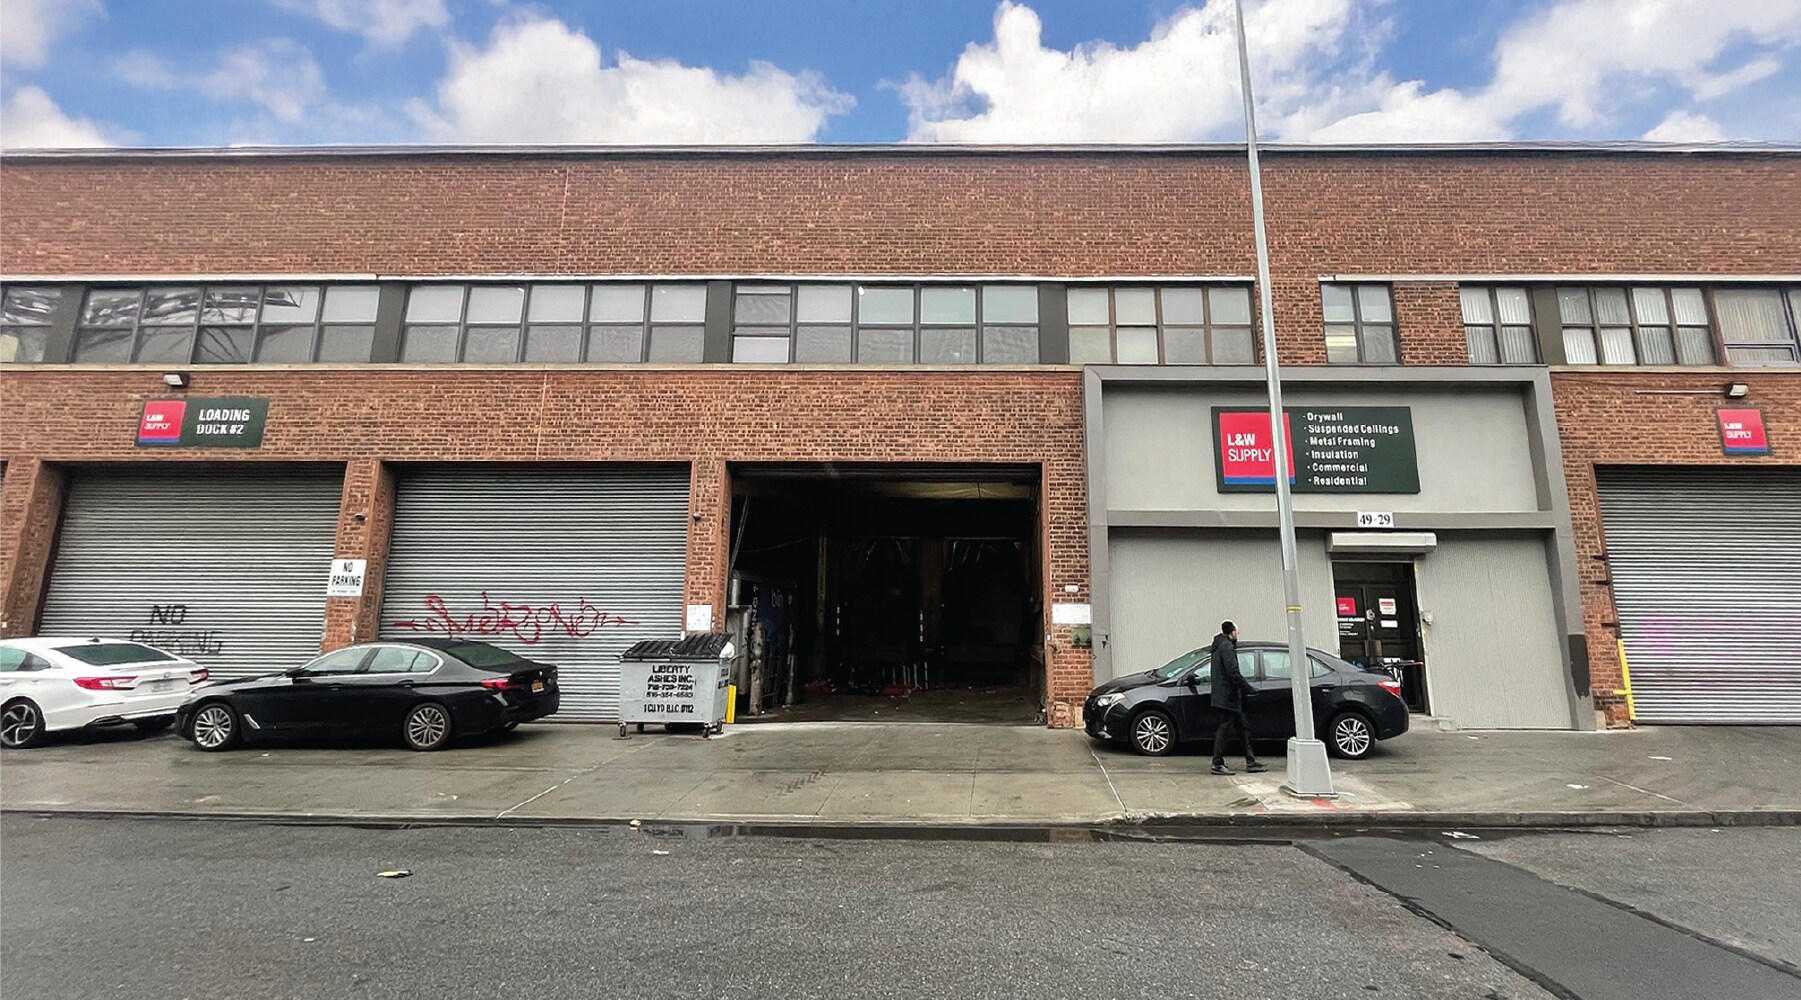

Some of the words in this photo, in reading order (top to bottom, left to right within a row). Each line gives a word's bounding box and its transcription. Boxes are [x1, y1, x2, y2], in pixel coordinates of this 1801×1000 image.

[198, 409, 250, 421] LOADING
[1307, 412, 1343, 422] Drywall
[196, 423, 228, 435] DOCK
[229, 423, 244, 435] #2
[1308, 425, 1359, 435] Suspended
[1361, 424, 1400, 434] Ceilings
[1725, 430, 1752, 439] SUPPLY
[1227, 433, 1256, 446] L&W
[1310, 437, 1336, 446] Metal
[1338, 437, 1376, 448] Framing
[1228, 449, 1272, 462] SUPPLY
[1311, 450, 1359, 460] Insulation
[1312, 463, 1368, 473] Commercial
[1313, 476, 1367, 486] Residential
[343, 562, 353, 573] NO
[332, 575, 361, 587] PARKING
[149, 604, 187, 625] NO
[652, 665, 691, 674] LIBERTY
[647, 674, 678, 683] ASHES
[678, 674, 695, 683] INC.
